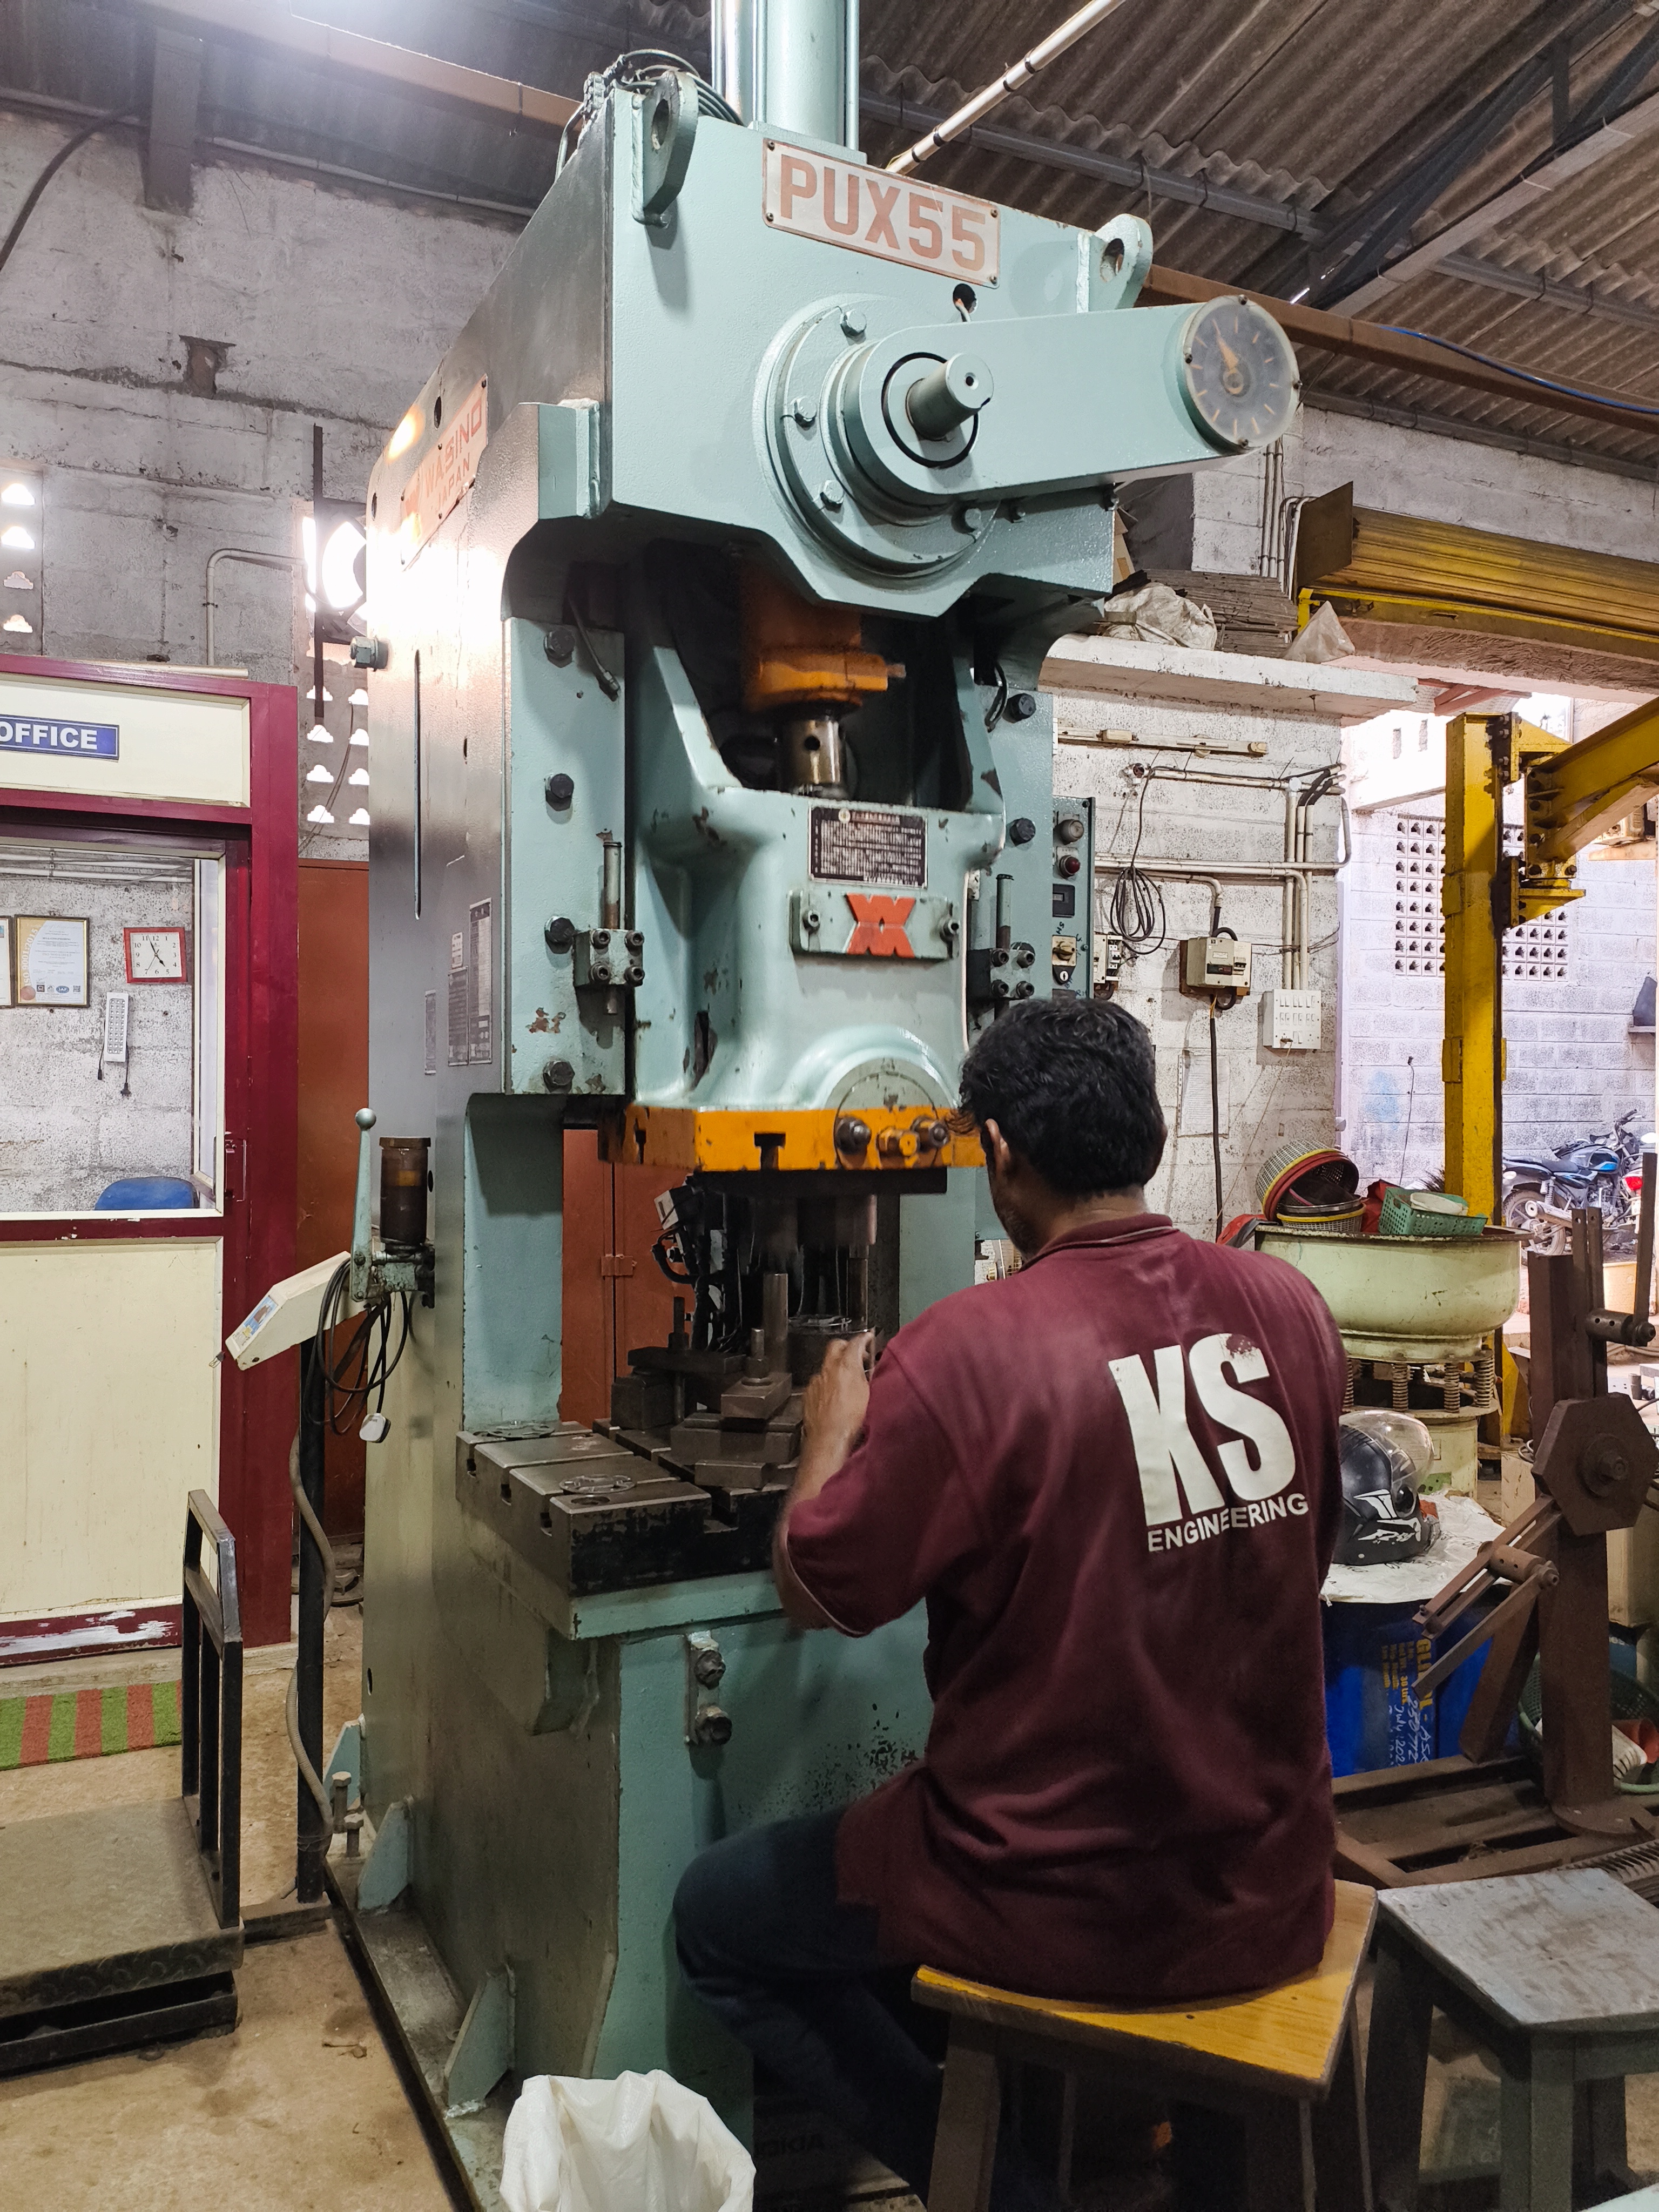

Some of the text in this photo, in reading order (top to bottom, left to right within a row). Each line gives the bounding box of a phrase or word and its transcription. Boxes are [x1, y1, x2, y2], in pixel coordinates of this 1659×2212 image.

[780, 154, 985, 271] PUX55
[424, 396, 482, 498] WASINO
[436, 452, 470, 514] JAPAN
[0, 721, 98, 750] OFFICE
[1108, 1333, 1296, 1526] KS
[1147, 1493, 1309, 1553] ENGINEERING
